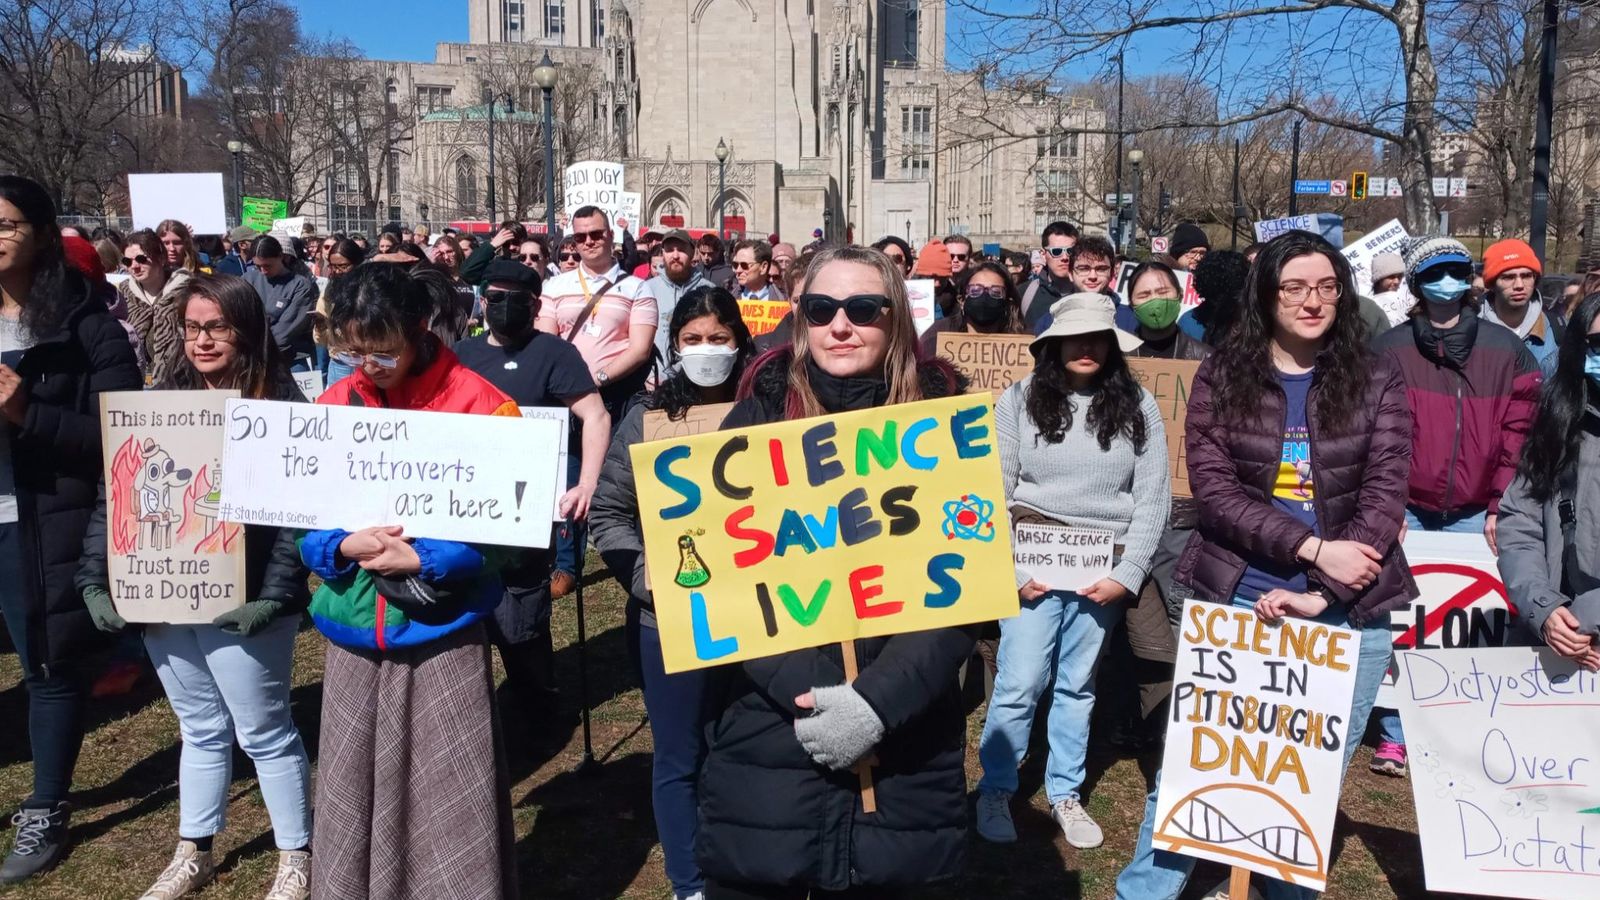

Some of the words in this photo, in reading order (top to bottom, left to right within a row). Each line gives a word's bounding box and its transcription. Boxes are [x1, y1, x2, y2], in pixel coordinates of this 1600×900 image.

[1260, 215, 1311, 232] SCIENCE
[1365, 225, 1402, 250] BEAKERS
[944, 341, 1029, 366] SCIENCE
[108, 410, 147, 427] This
[151, 411, 163, 426] is
[167, 411, 195, 426] not
[199, 409, 225, 426] fin
[231, 404, 267, 441] So
[289, 406, 332, 441] bad
[353, 421, 409, 443] even
[281, 446, 319, 478] the
[347, 451, 475, 482] introverts
[654, 405, 991, 520] SCIENCE
[395, 493, 433, 516] are
[725, 485, 921, 568] SAVES
[1017, 530, 1054, 544] BASIC
[1059, 533, 1111, 546] SCIENCE
[127, 554, 175, 575] Trust
[180, 559, 210, 575] me
[1016, 552, 1053, 565] LEADS
[1057, 553, 1077, 567] THE
[1082, 554, 1109, 568] WAY
[116, 579, 140, 599] I'm
[145, 583, 154, 599] a
[161, 580, 234, 610] Dogtor
[690, 553, 965, 661] LIVES
[1183, 604, 1352, 672] SCIENCE
[1190, 648, 1237, 684] IS
[1260, 661, 1308, 696] IN
[1404, 652, 1600, 718] Dictyosteli
[1173, 681, 1342, 751] PITTSBURGH'S
[1190, 726, 1310, 795] DNA
[1482, 728, 1590, 785] Over
[1455, 799, 1600, 872] Dictat
